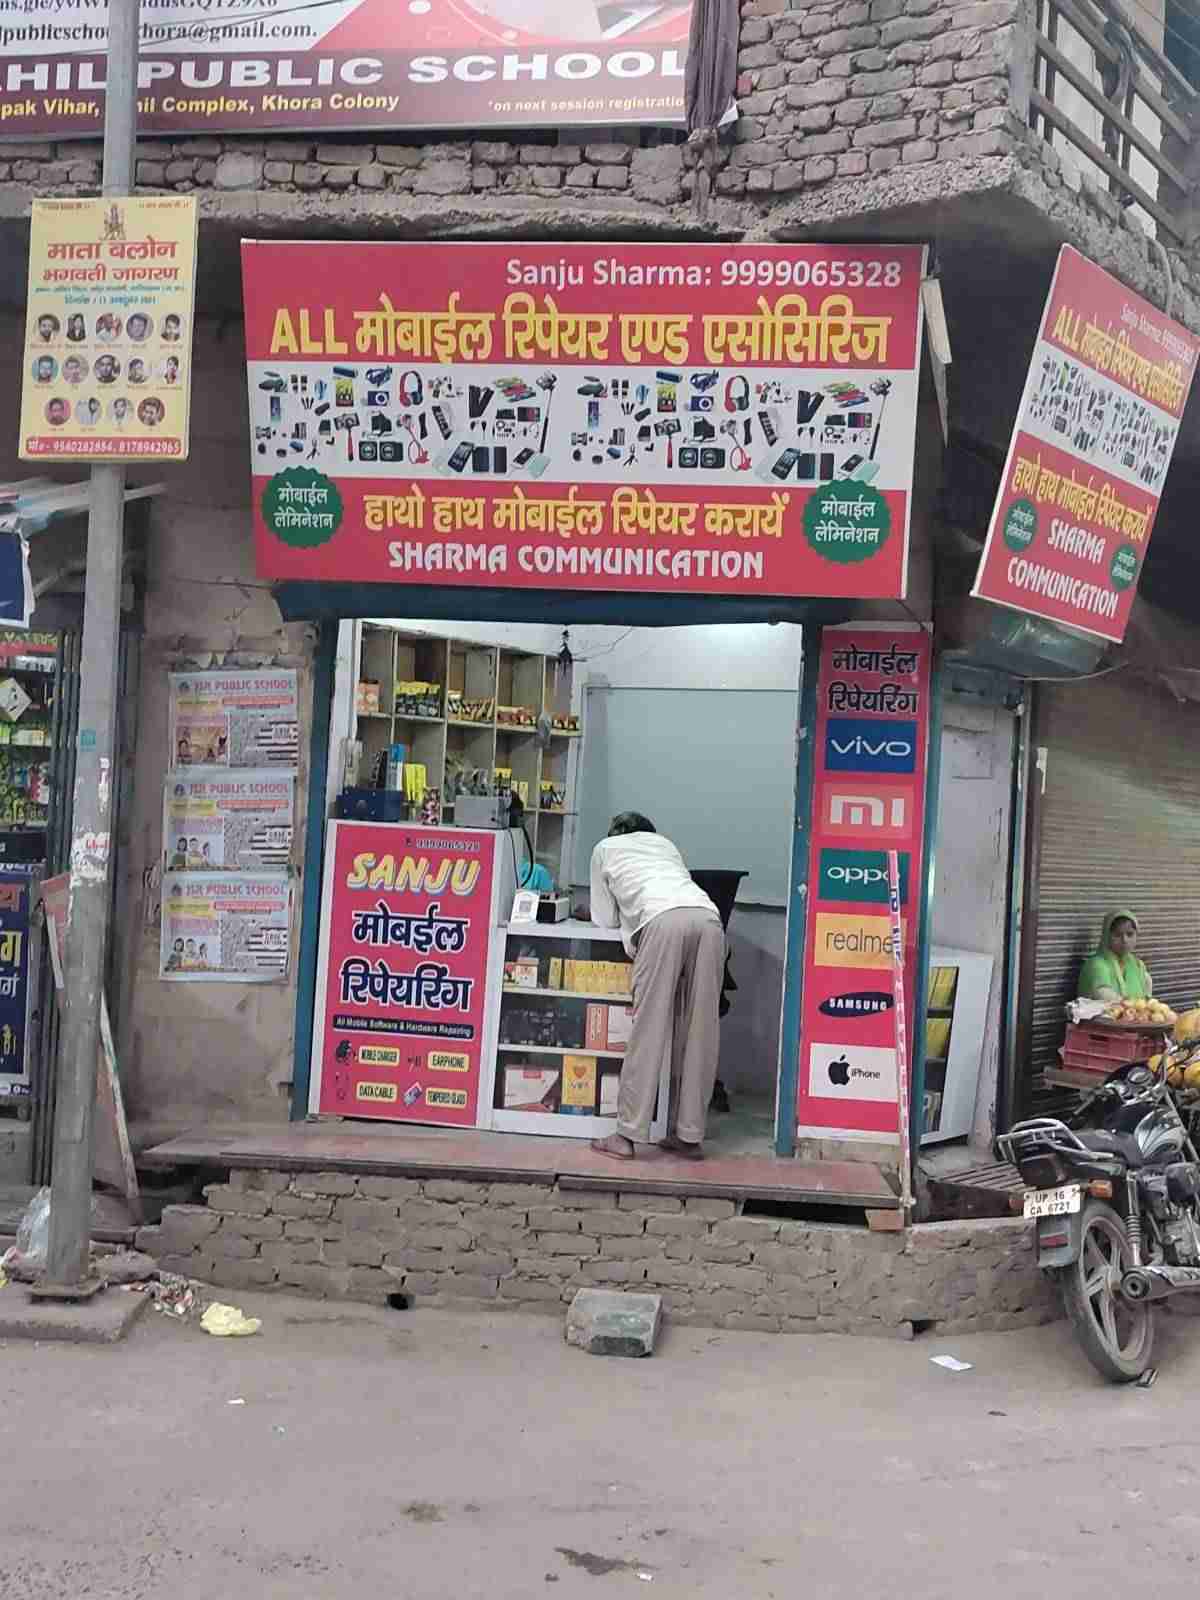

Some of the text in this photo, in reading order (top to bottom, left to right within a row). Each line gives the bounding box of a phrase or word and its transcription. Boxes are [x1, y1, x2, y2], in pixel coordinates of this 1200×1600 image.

[0, 50, 686, 91] HIL PUBLIC SCHOOL
[43, 97, 100, 118] Vihar,
[162, 95, 255, 116] Complex,
[262, 94, 322, 111] Khora
[330, 93, 399, 113] Colony
[514, 98, 545, 112] next
[551, 97, 603, 111] session
[47, 241, 101, 260] माता
[42, 263, 180, 281] भगवती जागरण
[507, 258, 901, 291] Sanju Sharma: 9999065328
[270, 291, 892, 365] ALL मोबाईल रिपेयर एण्ड एसोसिरिज
[1052, 304, 1080, 351] ALL
[278, 481, 328, 508] मोबाईल
[820, 493, 876, 520] मोबाईल
[274, 506, 334, 530] लेमिनेशन
[432, 496, 486, 534] हाथ
[492, 485, 606, 538] मोबाईल
[611, 486, 699, 538] रिपेयर
[703, 491, 791, 538] करायें
[814, 519, 880, 544] लेमिनेशन
[1048, 518, 1106, 564] SHARMA
[388, 541, 763, 579] SHARMA COMMUNICATION
[1008, 556, 1119, 618] COMMUNICATION
[832, 640, 920, 676] मोबाईल
[828, 681, 920, 713] रिपेयरिंग
[831, 735, 911, 757] vivo
[347, 852, 481, 896] SANJU
[825, 928, 893, 955] realme
[340, 957, 474, 1012] रिपेयरिंग
[829, 997, 887, 1011] SAMSUNG
[851, 1068, 880, 1080] iPhone
[359, 1084, 395, 1099] DATA CABLE
[1035, 1190, 1065, 1203] UP 16
